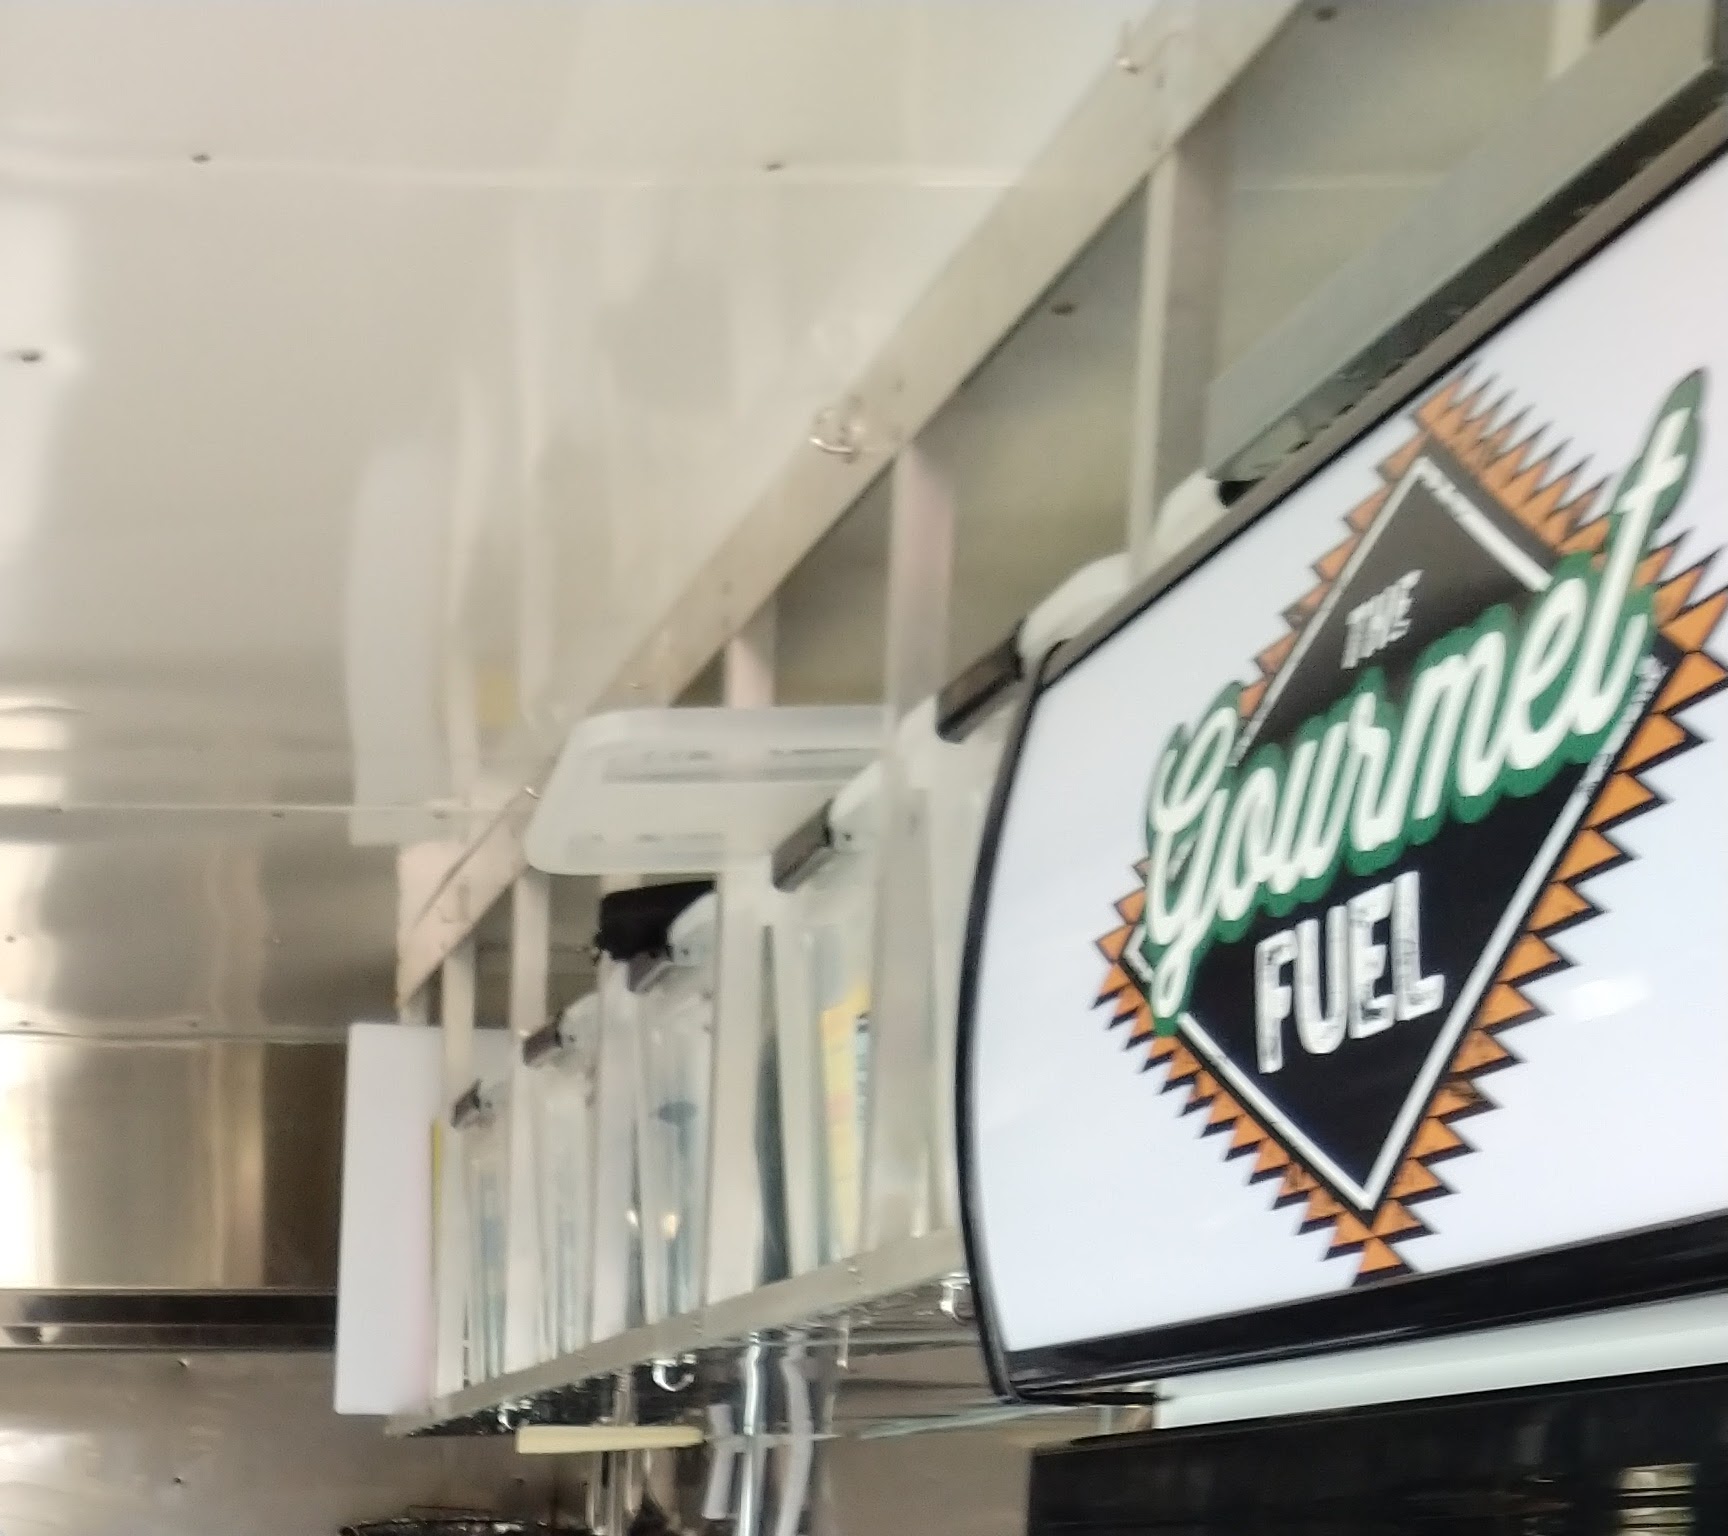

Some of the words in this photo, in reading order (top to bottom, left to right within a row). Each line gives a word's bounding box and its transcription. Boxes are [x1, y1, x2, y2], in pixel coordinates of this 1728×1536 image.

[1147, 402, 1692, 1018] Gourmet
[1342, 569, 1425, 669] THE
[1255, 871, 1445, 1073] FUEL
